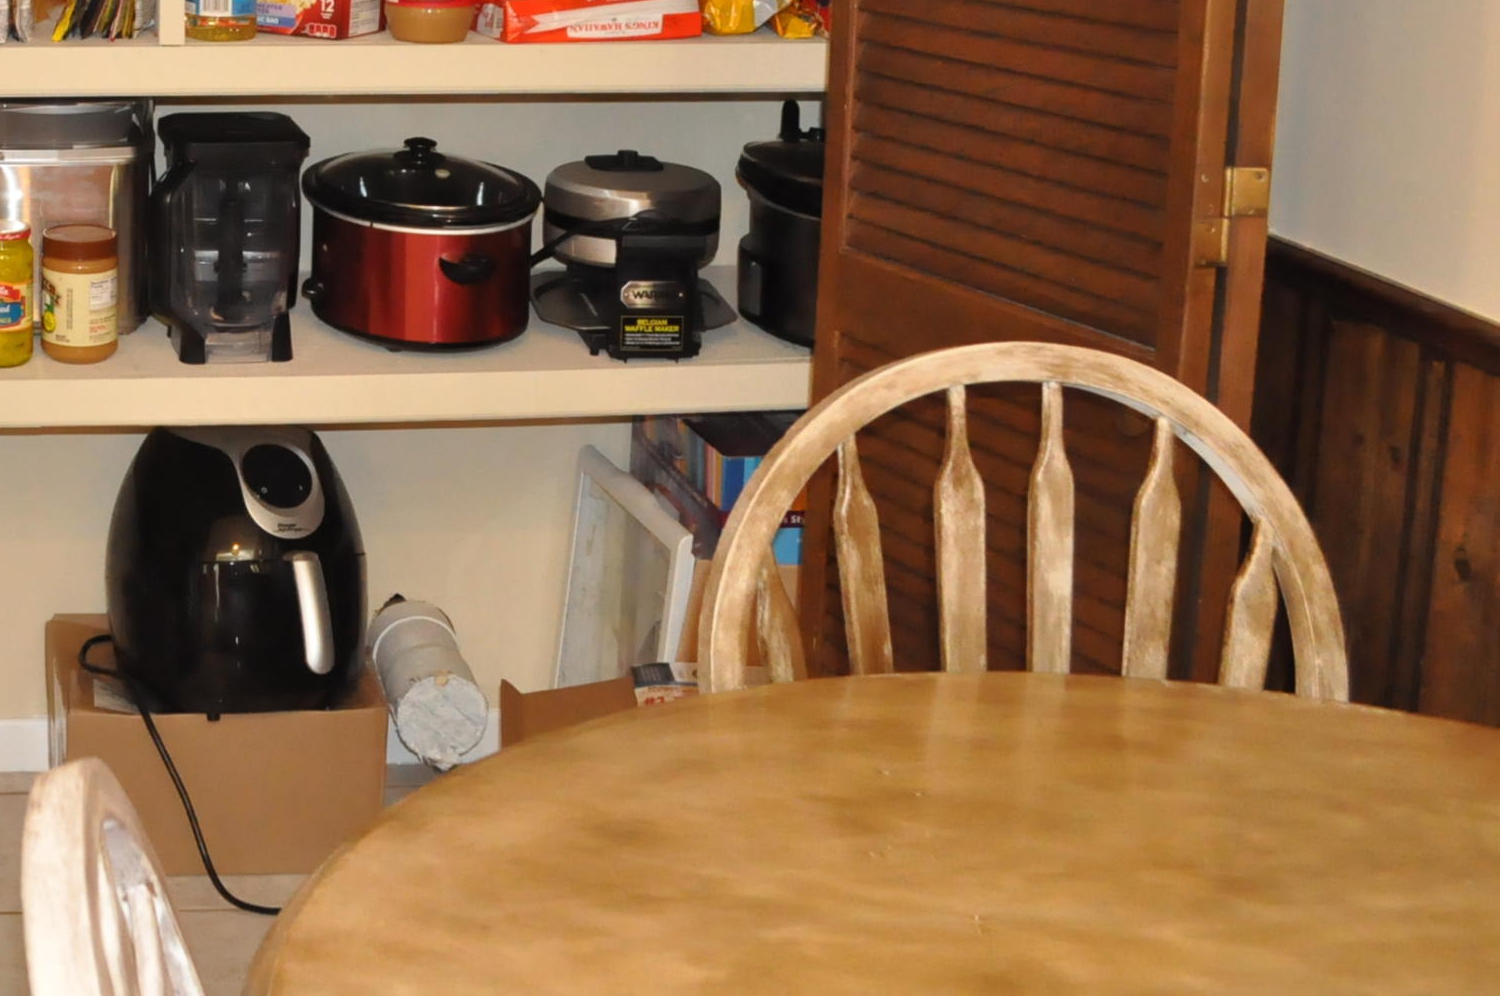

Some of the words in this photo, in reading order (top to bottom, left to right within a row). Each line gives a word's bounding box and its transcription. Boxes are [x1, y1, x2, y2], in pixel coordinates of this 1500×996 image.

[569, 22, 623, 34] HAWAIIAN
[624, 20, 660, 31] KING'S
[637, 318, 668, 326] BELGIAN
[624, 325, 653, 333] WAFFLE
[654, 325, 680, 333] MAKER
